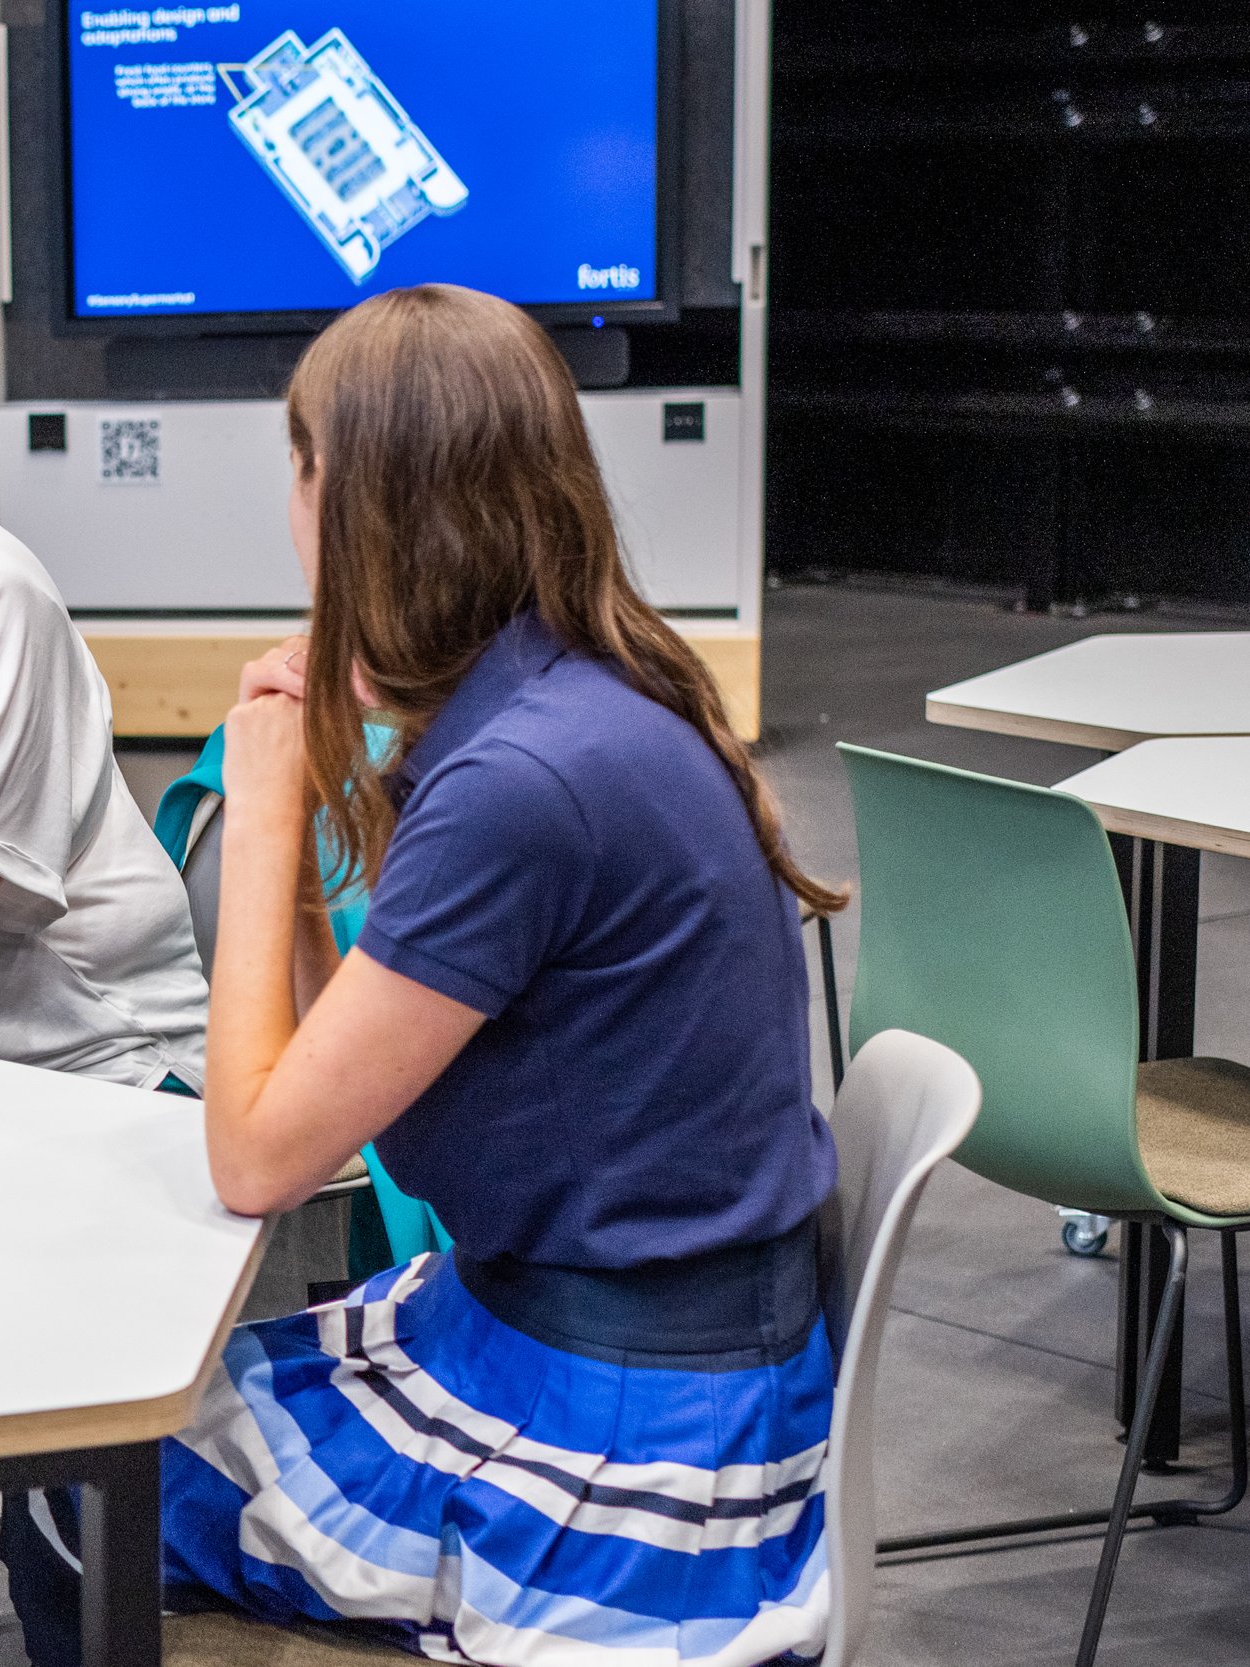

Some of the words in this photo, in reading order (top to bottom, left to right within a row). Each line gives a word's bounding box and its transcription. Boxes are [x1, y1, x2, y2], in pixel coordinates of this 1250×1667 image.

[81, 9, 150, 29] Enabling
[152, 6, 205, 28] design
[206, 3, 240, 23] and
[81, 27, 178, 48] adaptations
[577, 263, 640, 289] fortis
